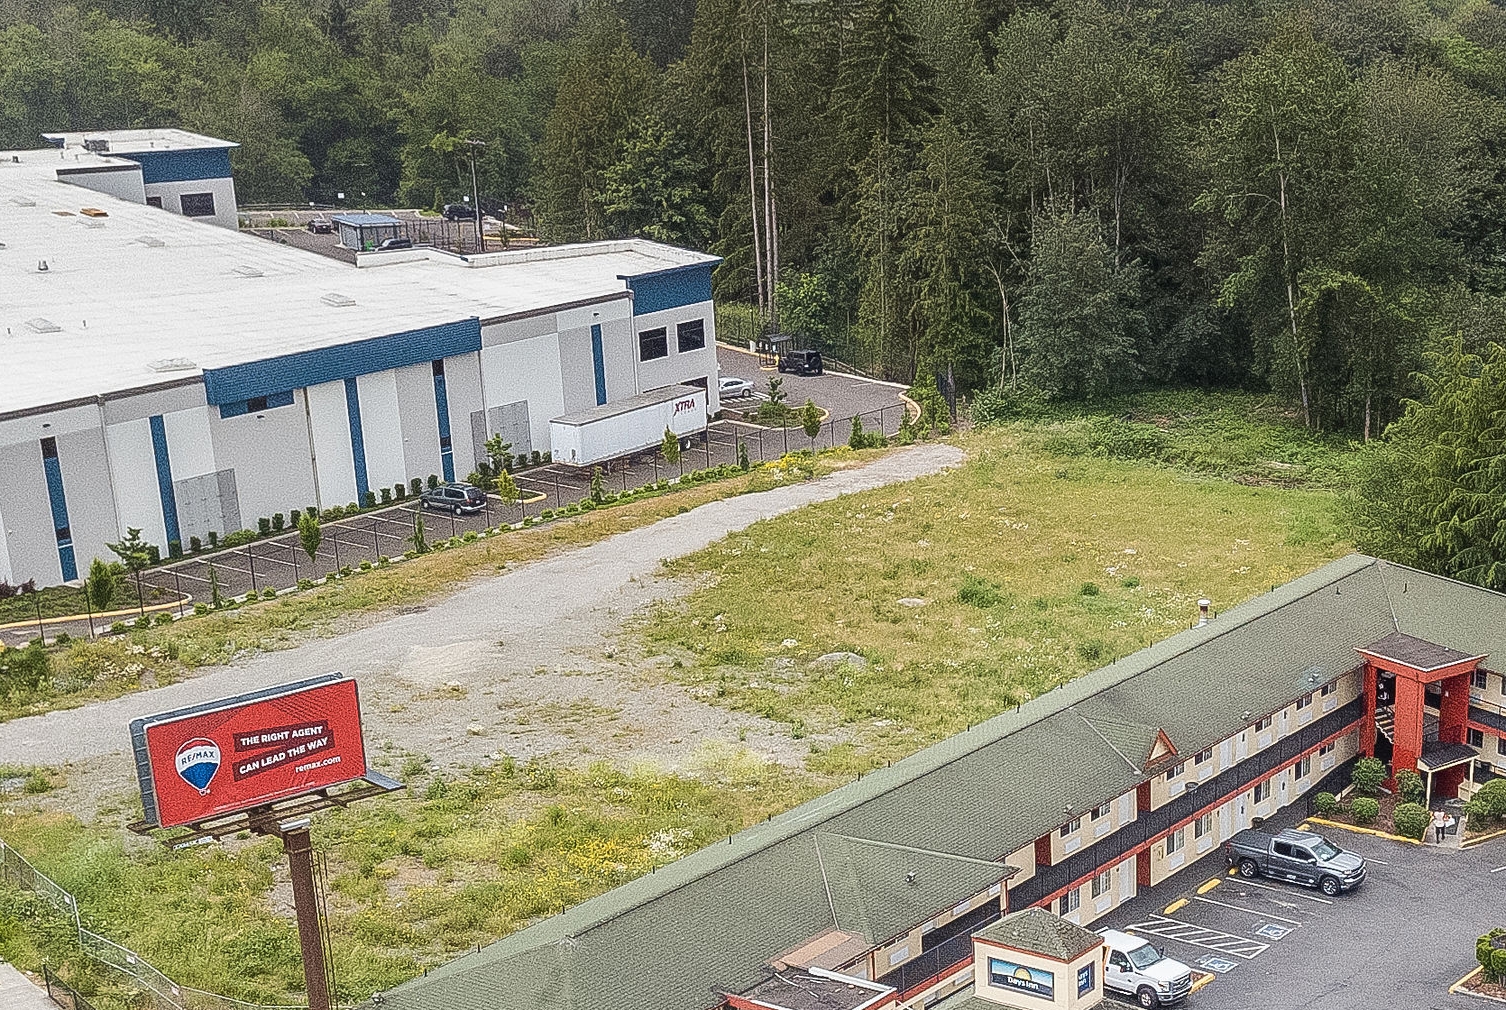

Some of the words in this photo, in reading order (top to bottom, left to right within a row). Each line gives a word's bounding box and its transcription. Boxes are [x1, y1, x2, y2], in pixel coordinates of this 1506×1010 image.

[674, 399, 695, 416] XTRA
[240, 736, 259, 746] THE
[261, 731, 290, 743] RIGHT
[292, 726, 323, 738] AGENT
[181, 750, 215, 766] RE/MAX
[239, 761, 260, 774] CAN
[261, 752, 286, 767] LEAD
[287, 744, 306, 758] THE
[307, 737, 328, 750] WAY
[295, 756, 342, 773] remax.com
[1007, 976, 1026, 986] Days
[1026, 980, 1039, 990] Inn
